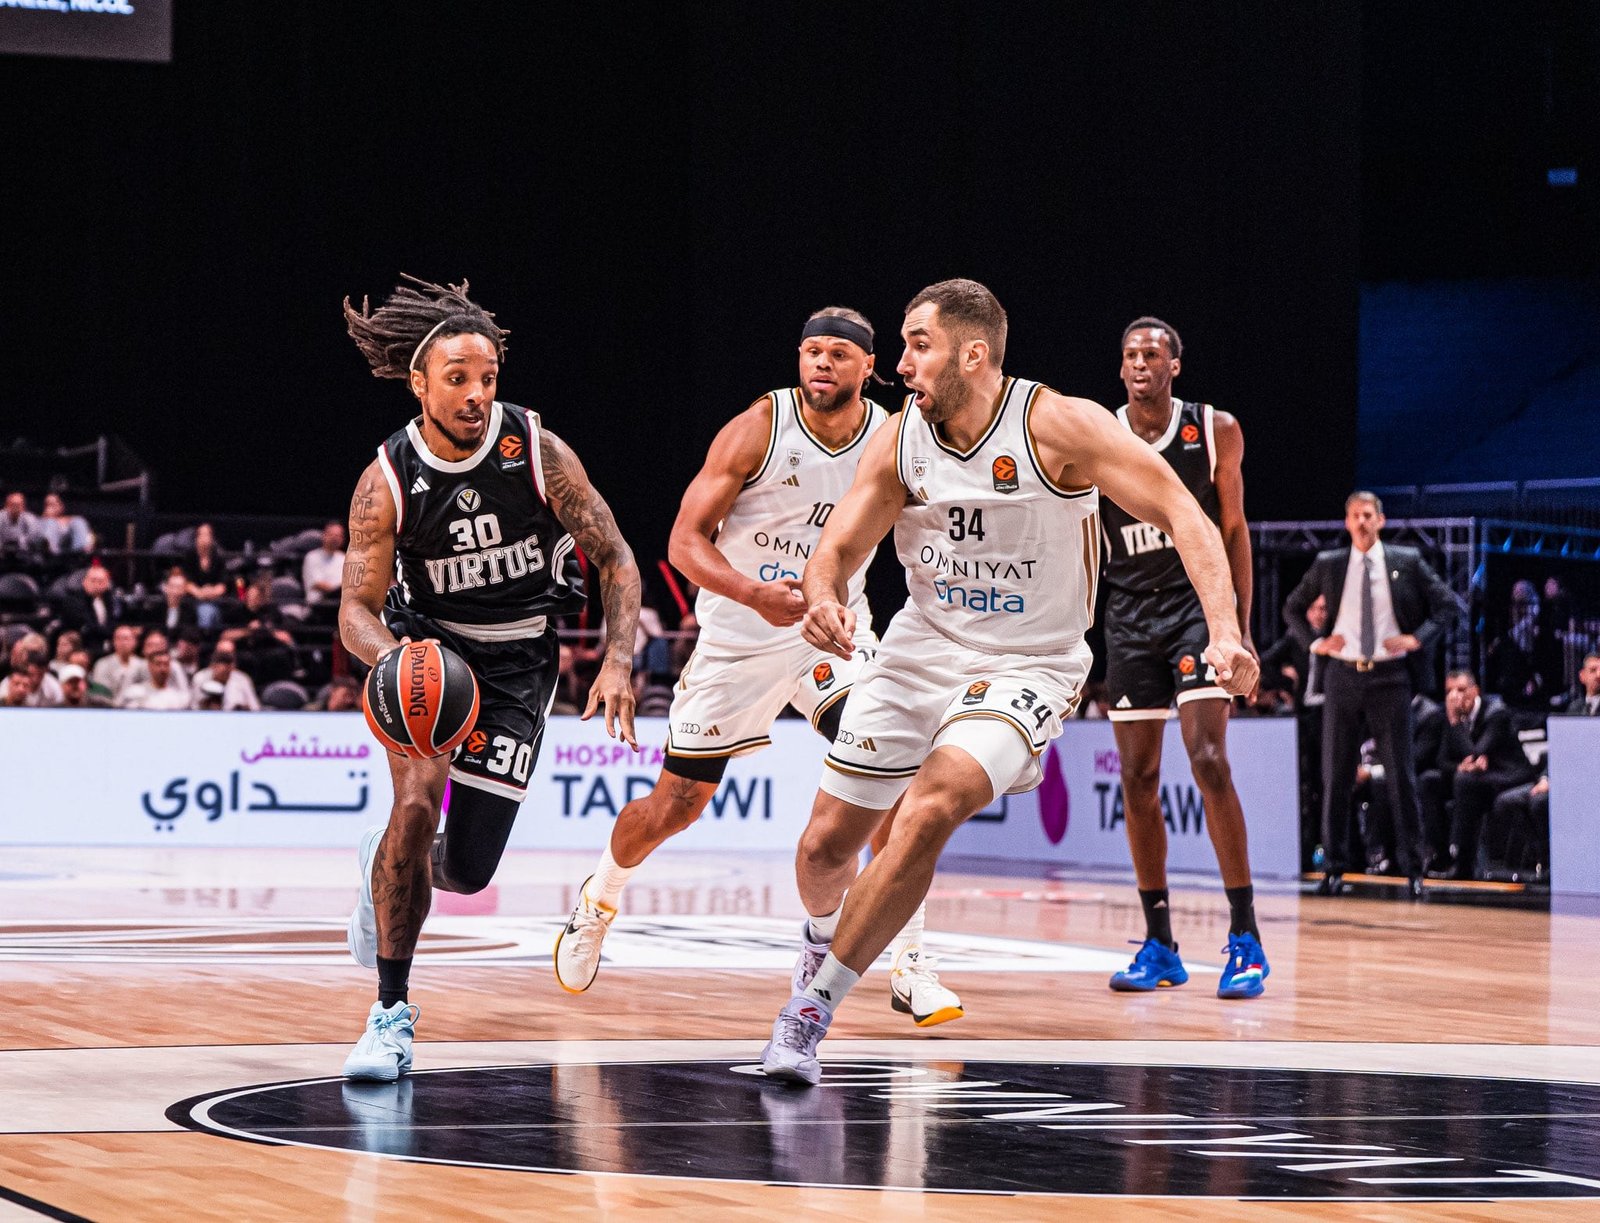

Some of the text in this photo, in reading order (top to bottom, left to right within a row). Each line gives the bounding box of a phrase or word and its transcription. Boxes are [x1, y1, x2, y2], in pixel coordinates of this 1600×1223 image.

[448, 513, 503, 551] 30
[806, 501, 835, 528] 10
[948, 506, 985, 542] 34
[1120, 521, 1174, 556] VIR
[425, 534, 545, 594] VIRTUS
[920, 545, 1037, 579] OMNIYAT
[933, 579, 1024, 613] dnata
[1010, 688, 1052, 731] 34
[486, 734, 532, 783] 30
[552, 773, 772, 819] TADWI
